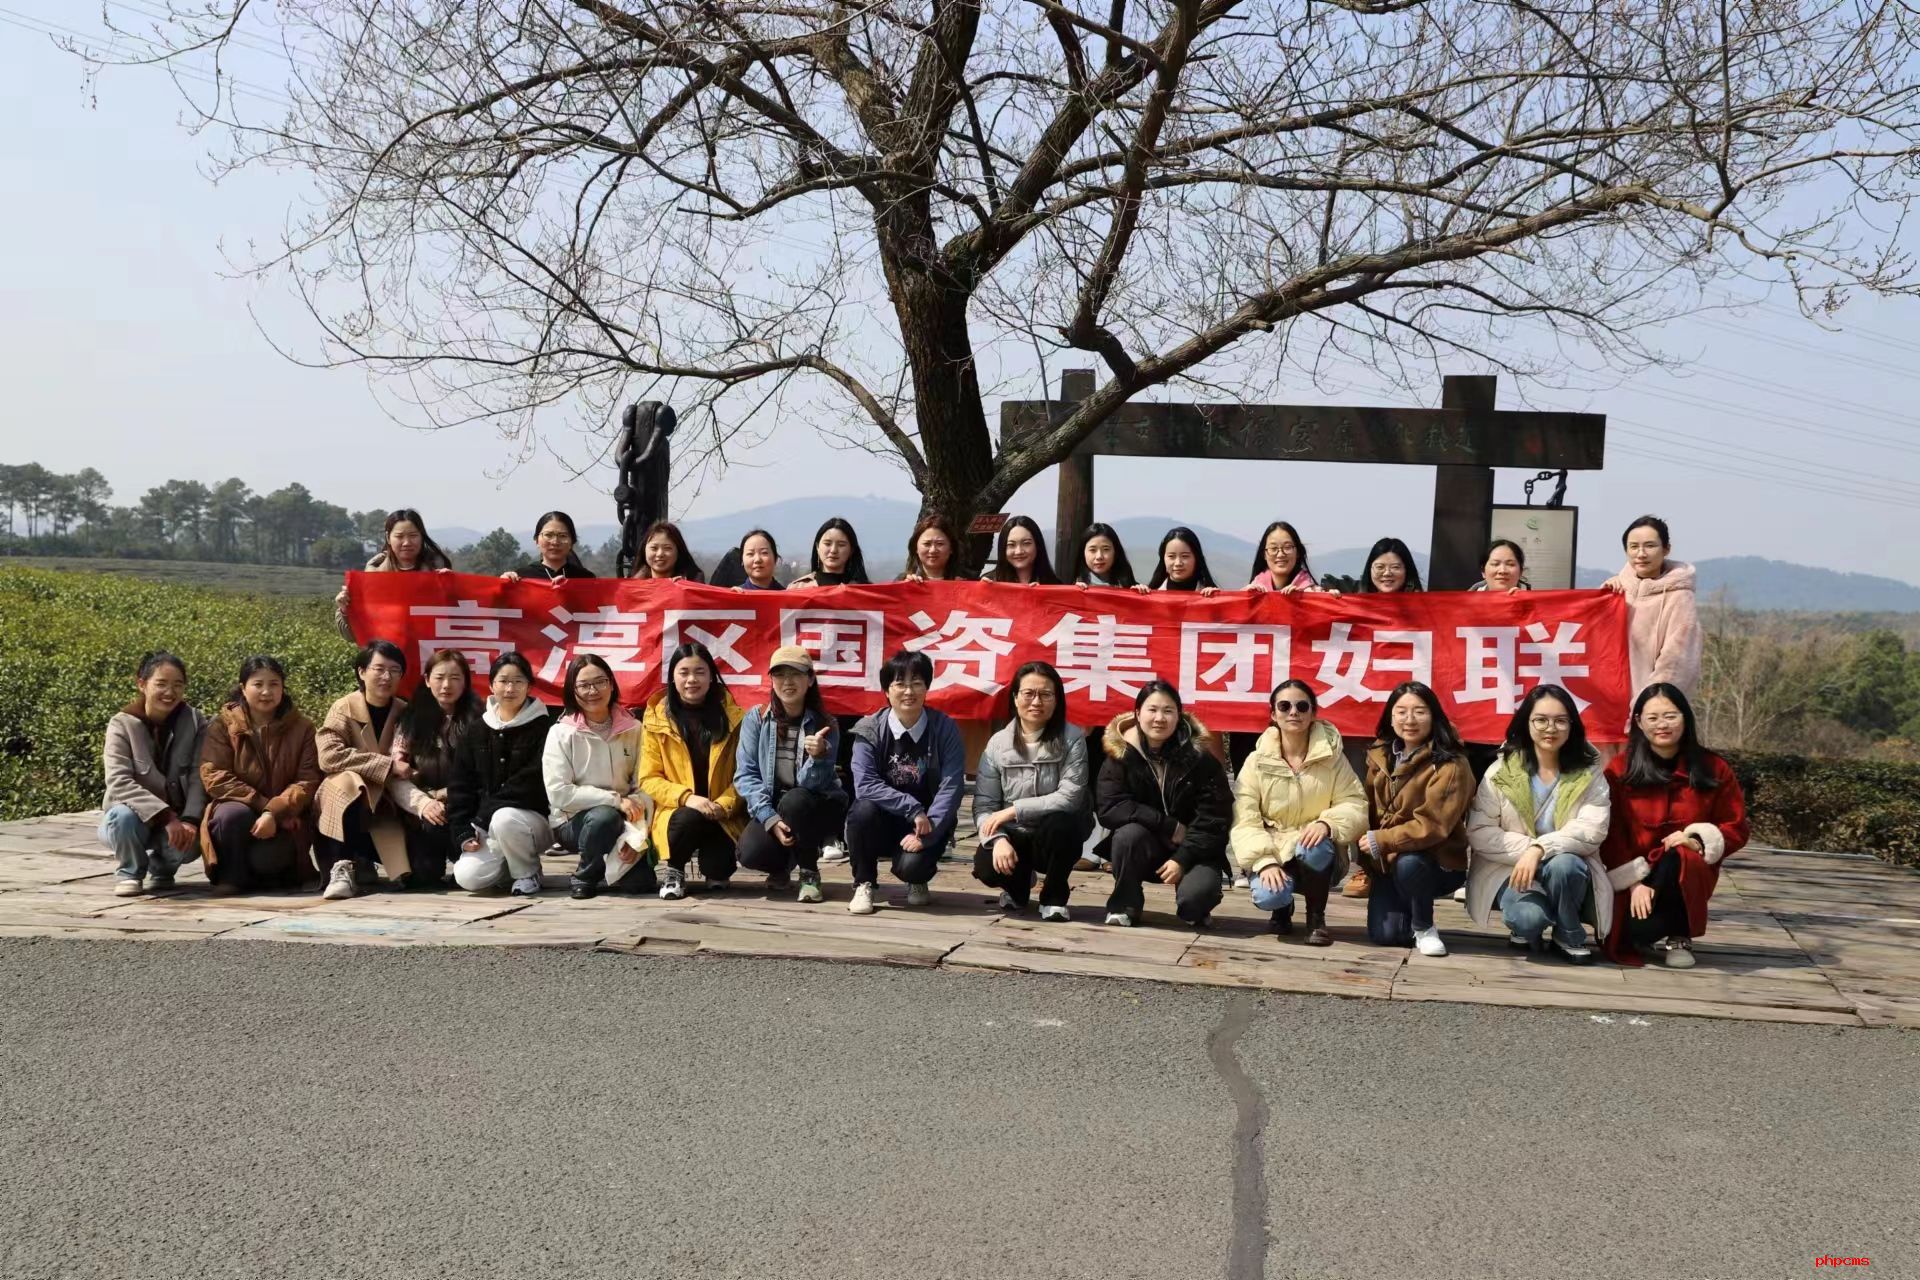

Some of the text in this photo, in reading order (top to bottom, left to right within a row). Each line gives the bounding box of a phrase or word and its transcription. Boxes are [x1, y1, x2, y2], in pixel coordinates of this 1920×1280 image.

[409, 600, 1592, 715] 高淳区国资集团妇联
